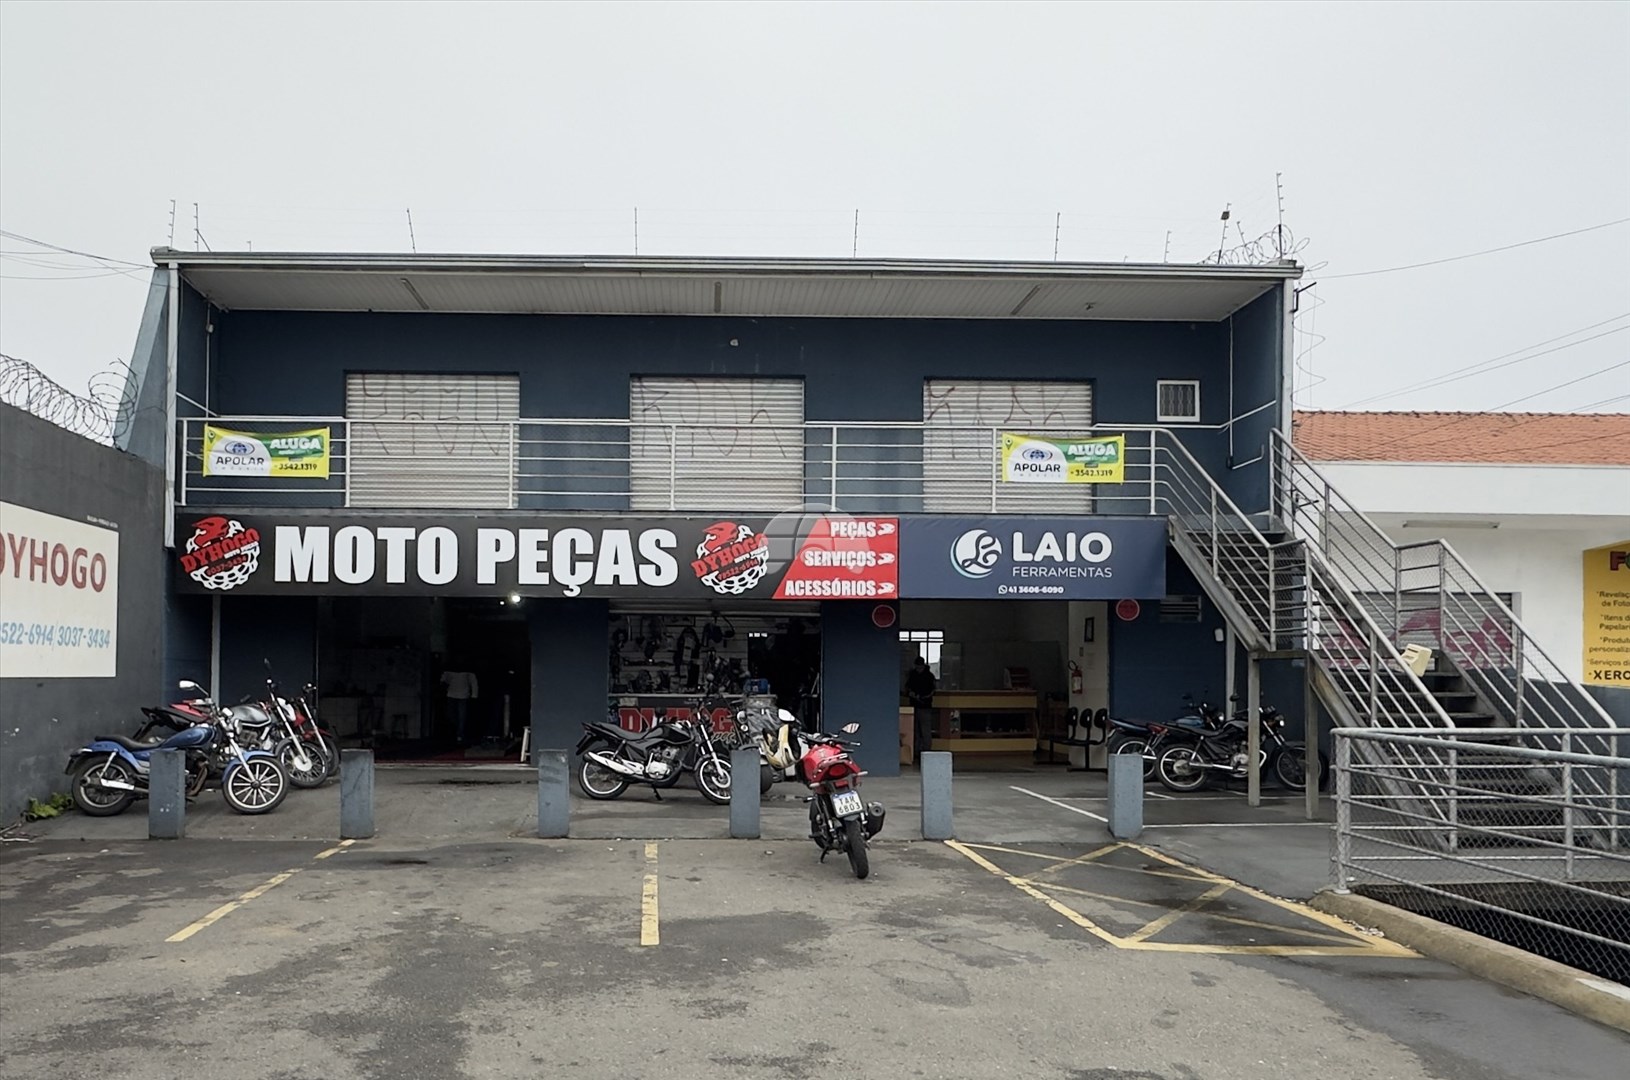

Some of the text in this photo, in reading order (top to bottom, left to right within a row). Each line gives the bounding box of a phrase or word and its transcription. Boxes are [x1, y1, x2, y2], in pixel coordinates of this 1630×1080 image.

[270, 437, 321, 450] ALUGA
[1067, 443, 1117, 456] ALUGA
[216, 456, 265, 466] APOLAR
[278, 463, 318, 471] 3542.1319
[1013, 463, 1061, 473] APOLAR
[830, 521, 877, 540] PEÇAS
[180, 528, 260, 574] DYHOGO
[690, 533, 769, 578] DYHOGO
[1012, 531, 1113, 563] LAIO
[0, 531, 107, 593] YHOGO
[274, 525, 679, 598] MOTO PEÇAS
[804, 550, 877, 570] SERVIÇOS
[1012, 566, 1113, 578] FERRAMENTAS
[784, 577, 877, 597] ACESSÓRIOS
[1008, 585, 1018, 594] 41
[0, 622, 110, 648] 522-6914 3037-3434
